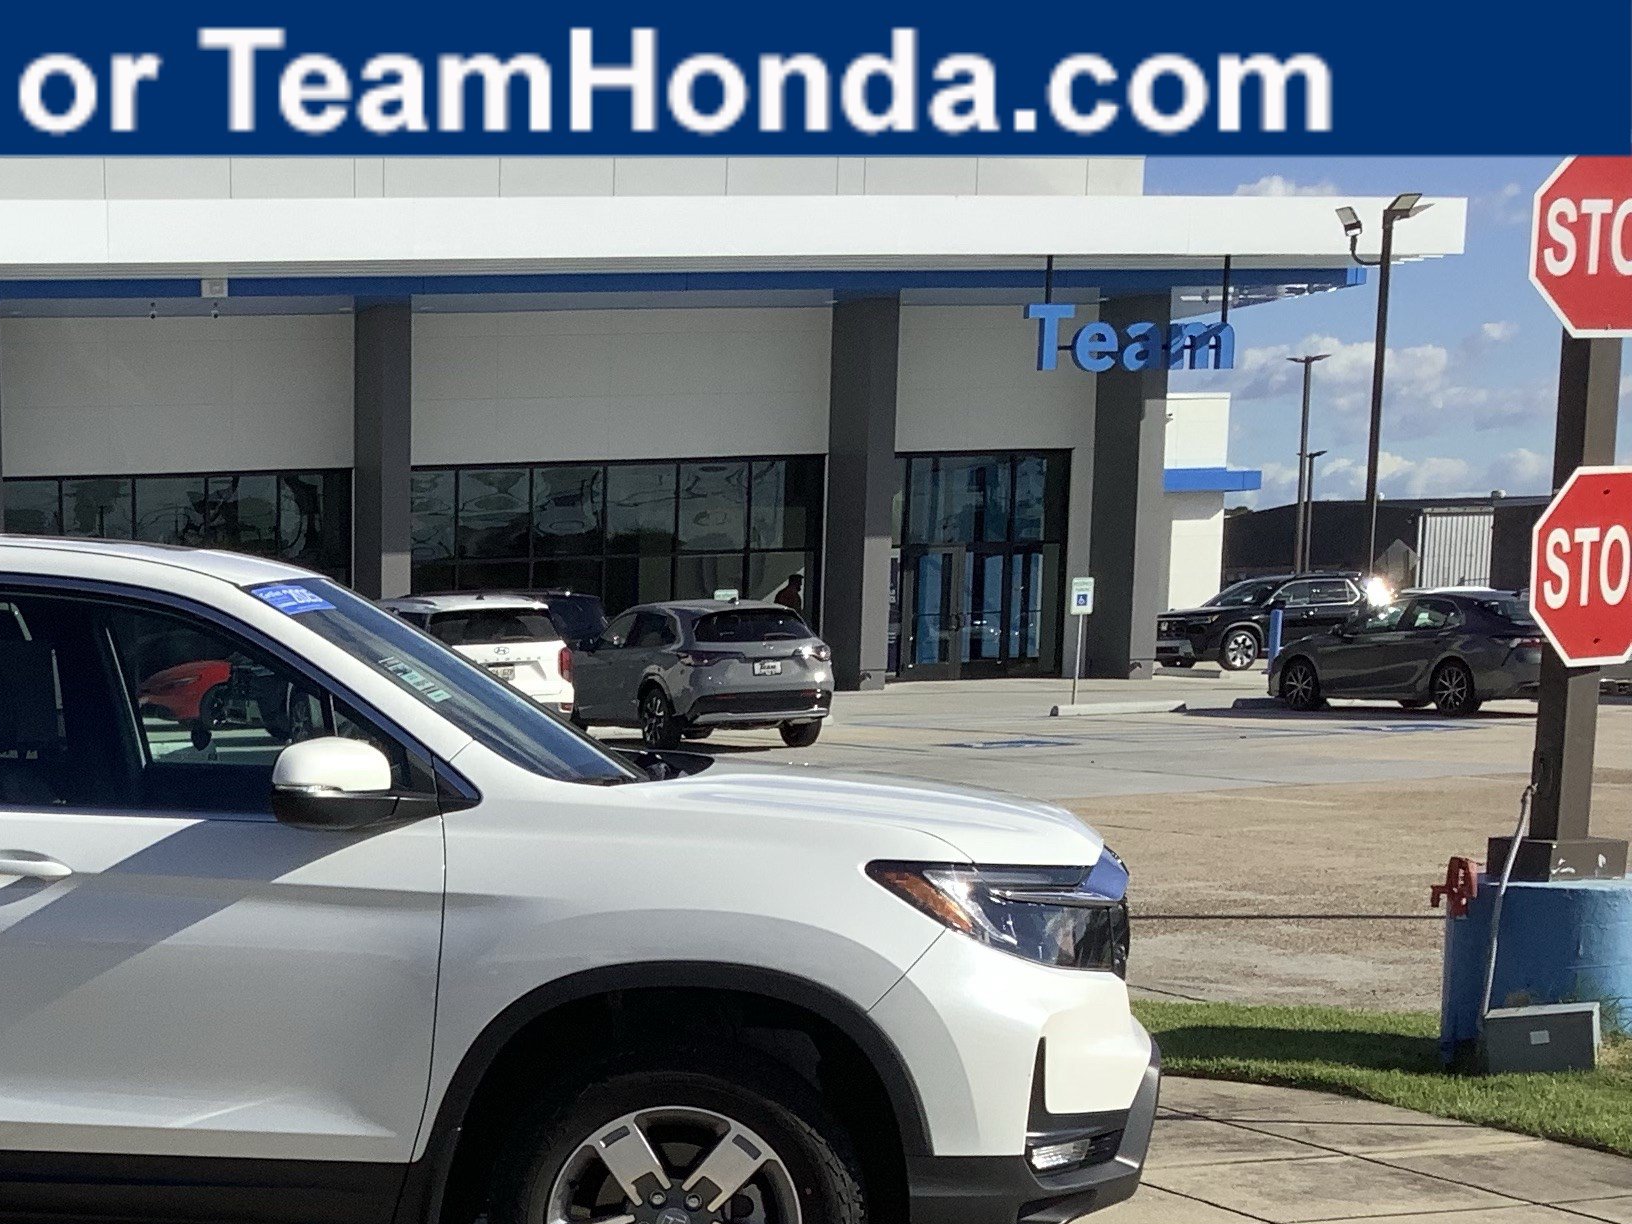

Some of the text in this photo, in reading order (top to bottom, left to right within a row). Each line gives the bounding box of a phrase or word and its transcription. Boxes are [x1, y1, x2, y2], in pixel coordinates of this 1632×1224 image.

[1543, 197, 1632, 277] STO
[1024, 303, 1235, 372] Team
[1543, 524, 1631, 610] STO
